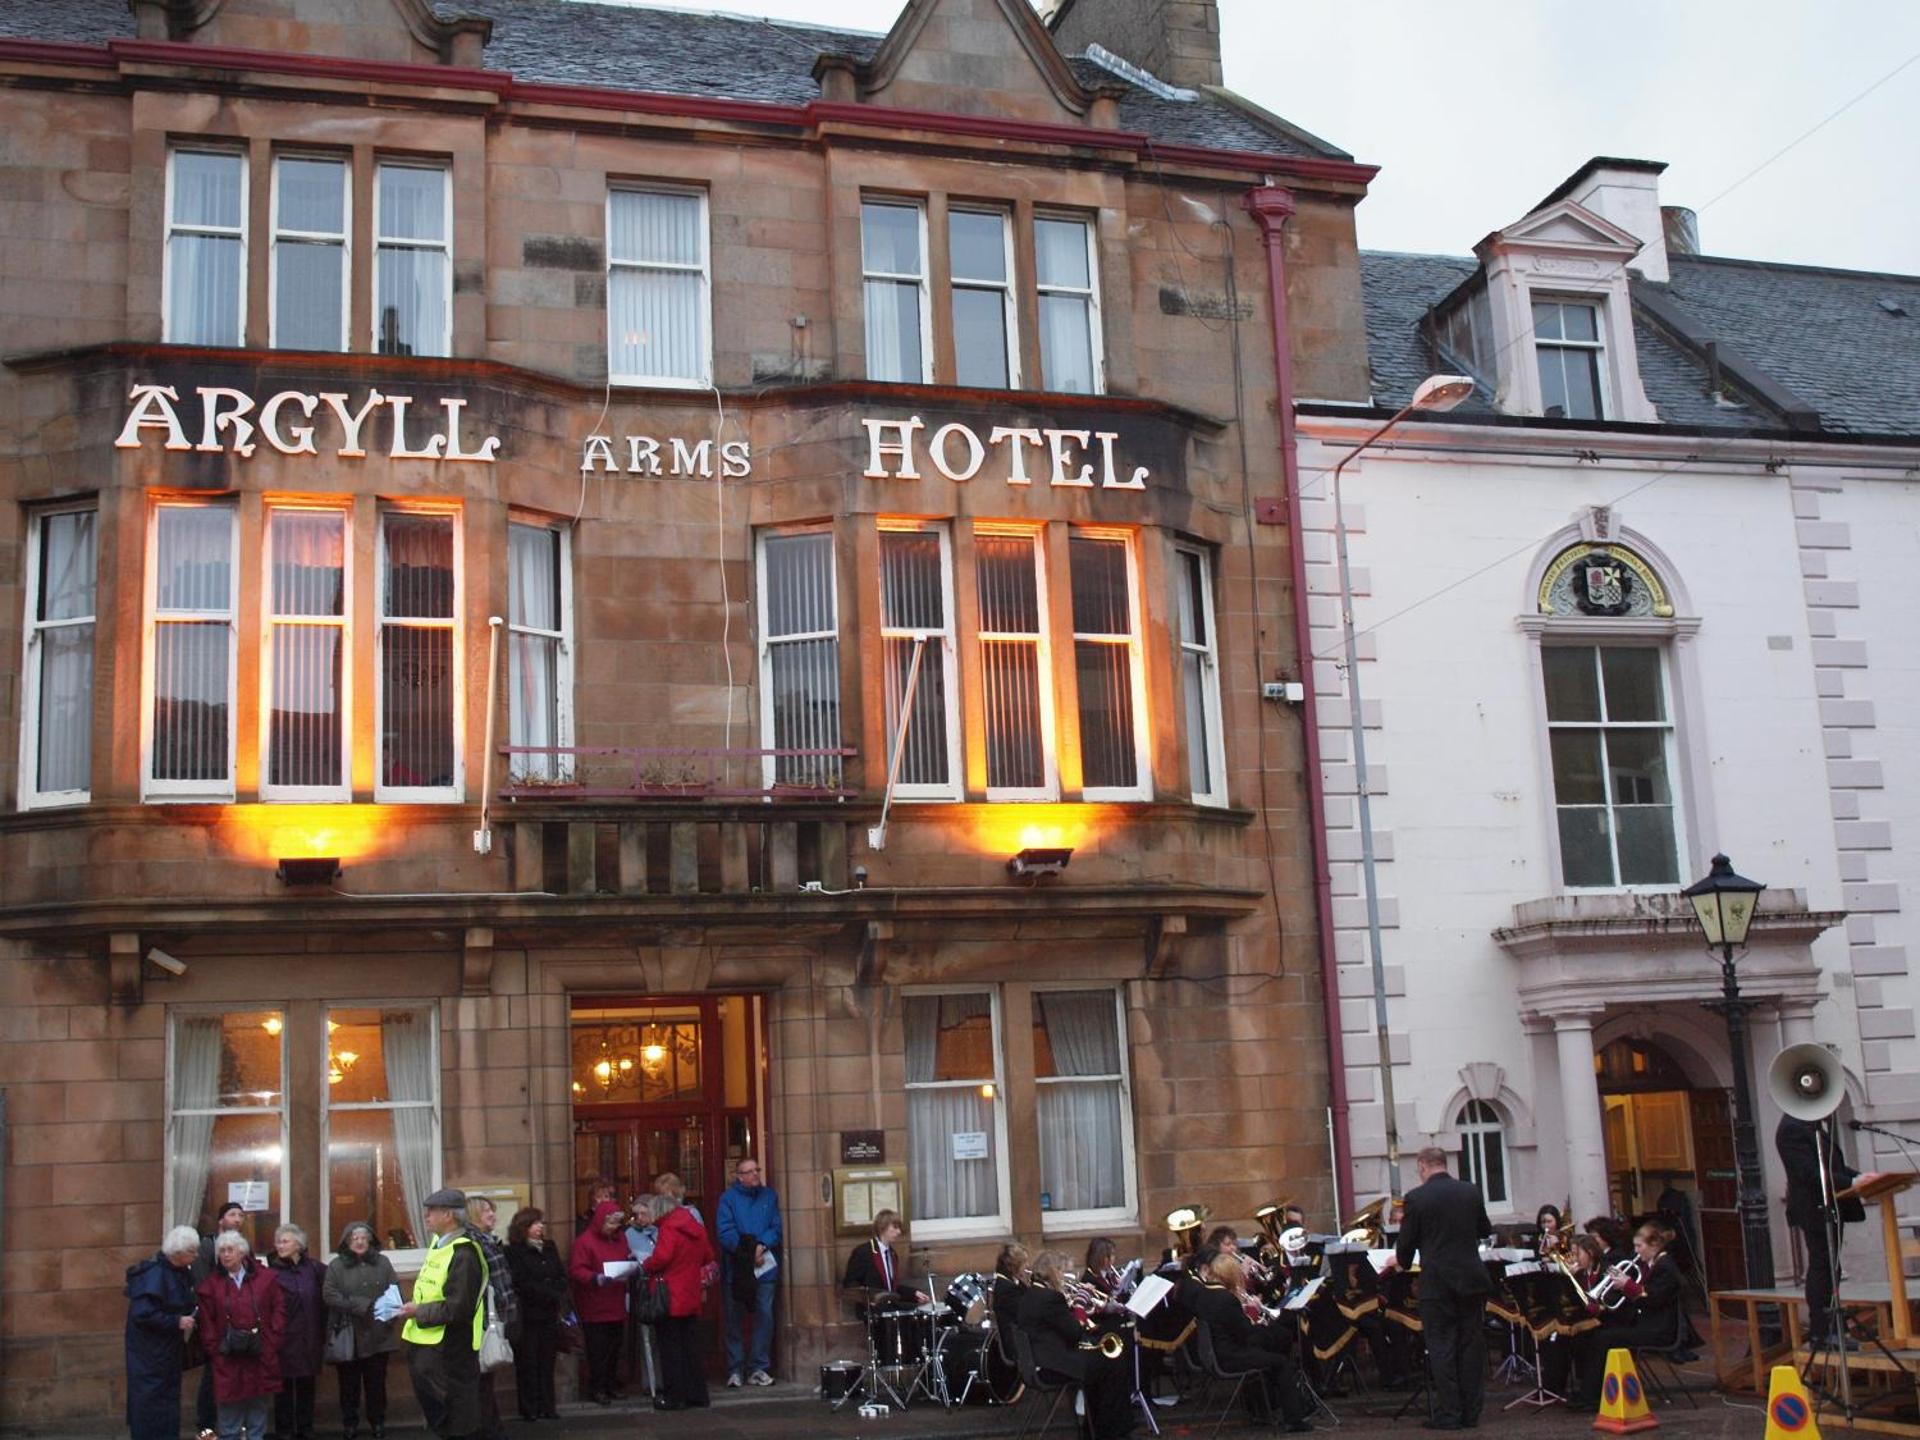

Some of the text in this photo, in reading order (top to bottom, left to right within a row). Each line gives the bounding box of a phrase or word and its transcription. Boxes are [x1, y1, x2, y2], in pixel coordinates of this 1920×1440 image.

[114, 384, 1149, 490] ARGYLL ARMS HOTEL
